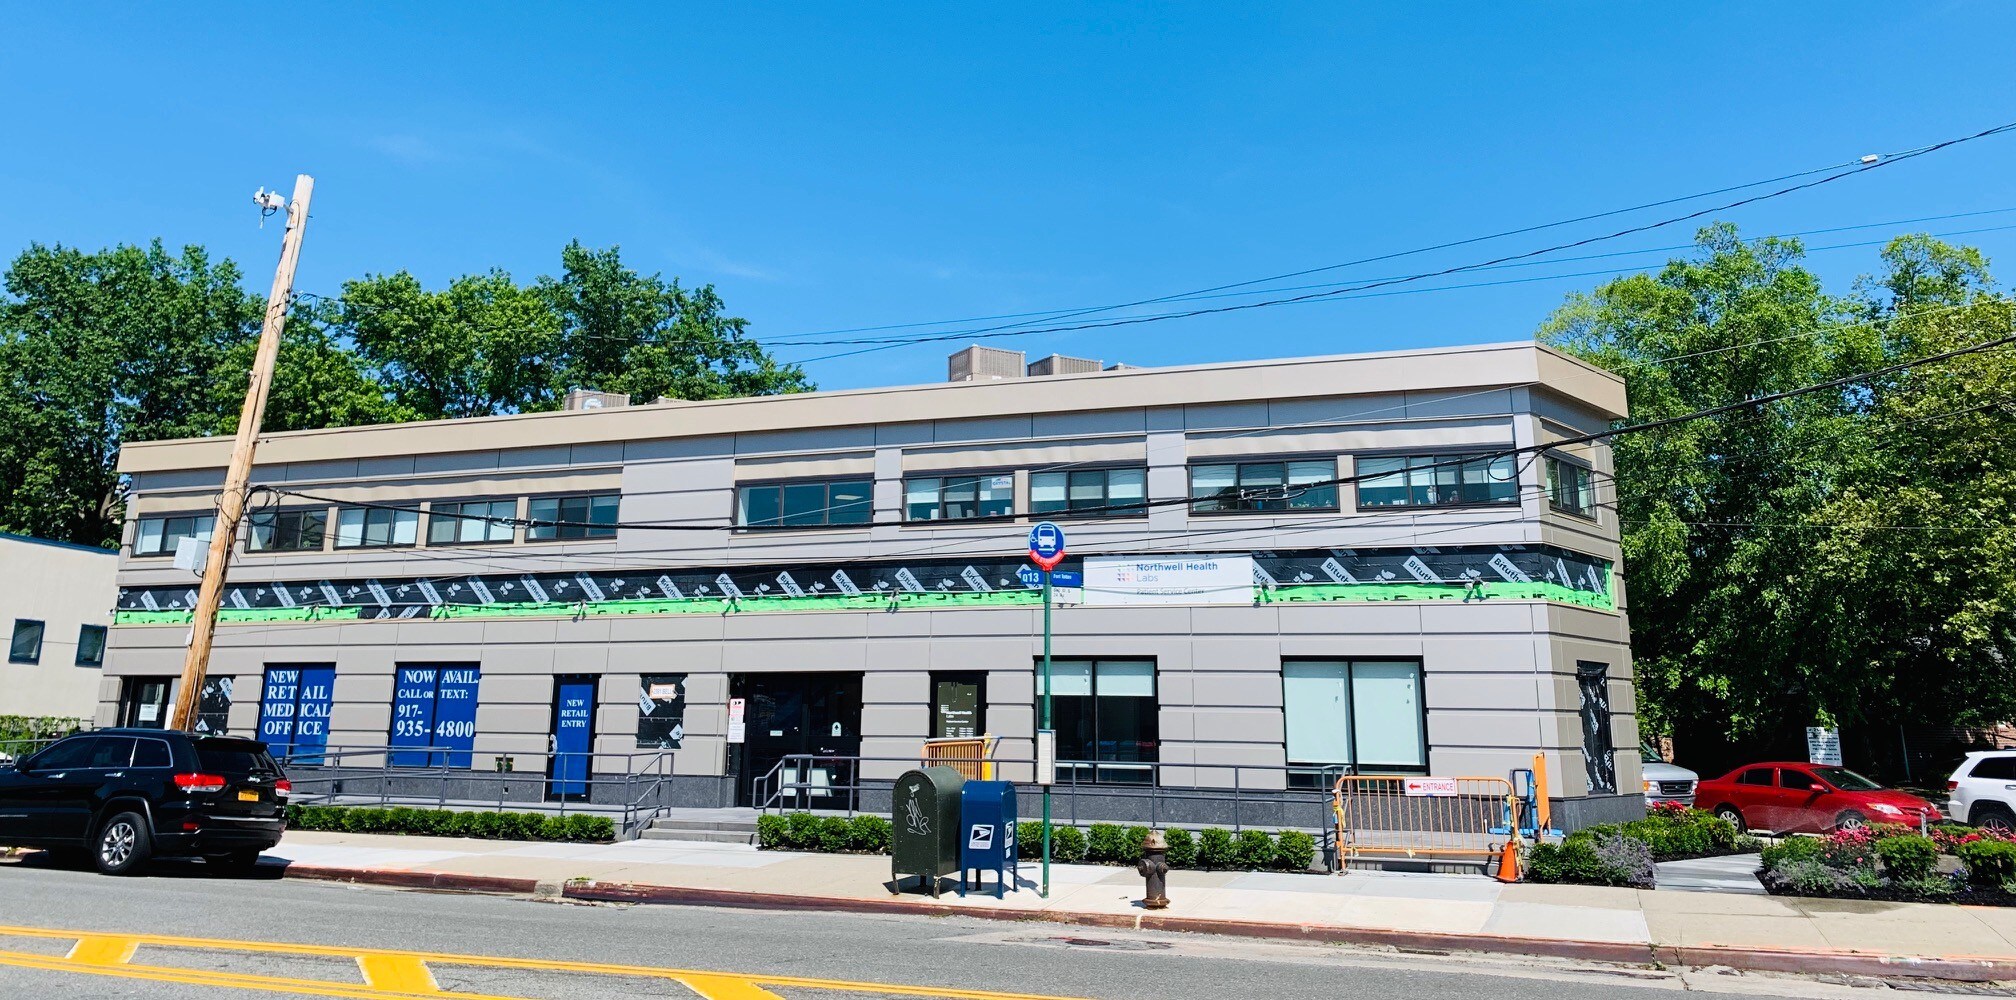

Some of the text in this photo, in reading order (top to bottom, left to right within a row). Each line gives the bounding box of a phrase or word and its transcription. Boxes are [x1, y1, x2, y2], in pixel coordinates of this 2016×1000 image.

[1136, 562, 1218, 571] Northwell Health
[1326, 561, 1350, 583] Bituth
[1408, 559, 1433, 581] Bituth
[835, 573, 853, 593] Bituth
[899, 571, 918, 591] Bituth
[1022, 572, 1039, 583] Q13
[1136, 573, 1159, 582] Labs
[780, 574, 797, 595] Bituth
[269, 670, 299, 684] NEW
[404, 670, 479, 684] NOW AVAIL.
[398, 689, 469, 699] CALL OR TEXT:
[566, 699, 585, 707] NEW
[398, 704, 423, 718] 917-
[561, 709, 588, 718] RETAIL
[561, 719, 586, 728] ENTRY
[1422, 782, 1454, 791] ENTRANCE
